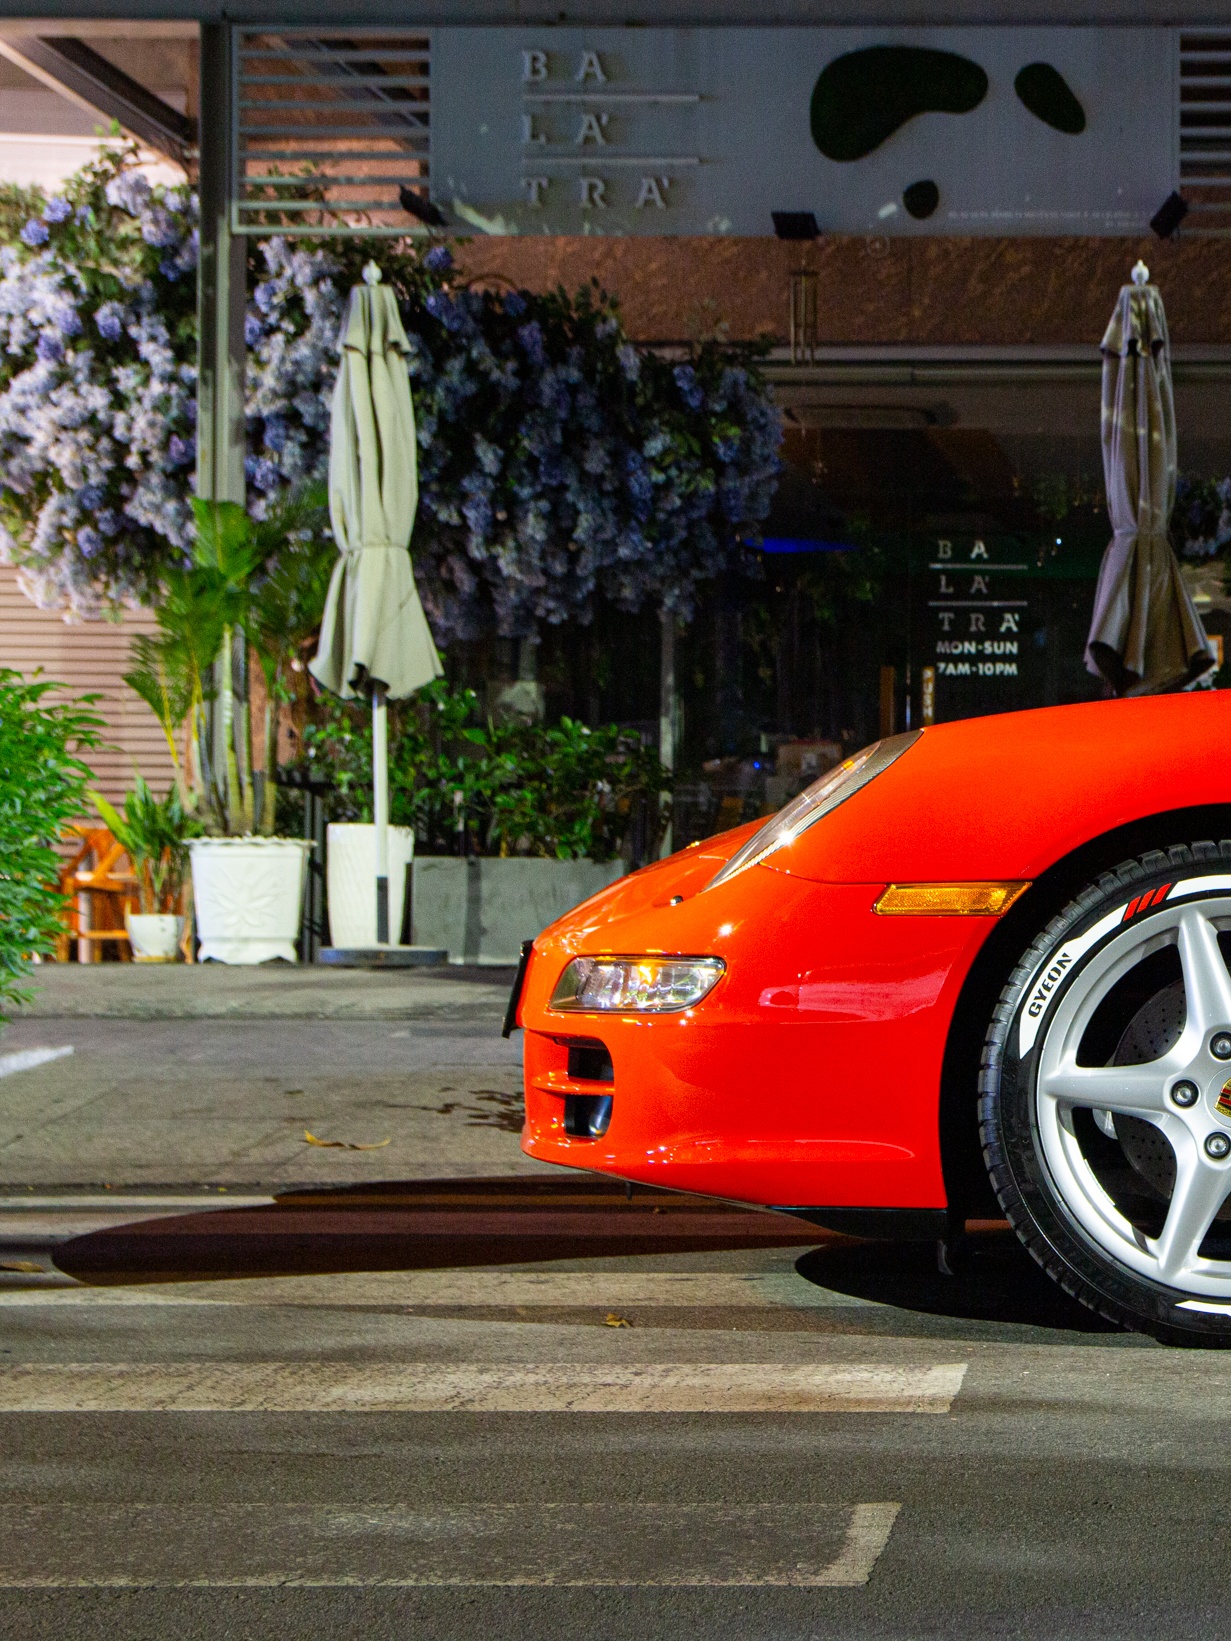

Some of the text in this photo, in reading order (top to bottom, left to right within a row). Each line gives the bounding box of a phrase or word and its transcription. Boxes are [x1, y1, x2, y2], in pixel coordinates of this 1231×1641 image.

[936, 641, 1018, 655] MON-SUN
[936, 662, 1018, 676] 7AM-10PM
[1028, 952, 1073, 1018] GYEON
